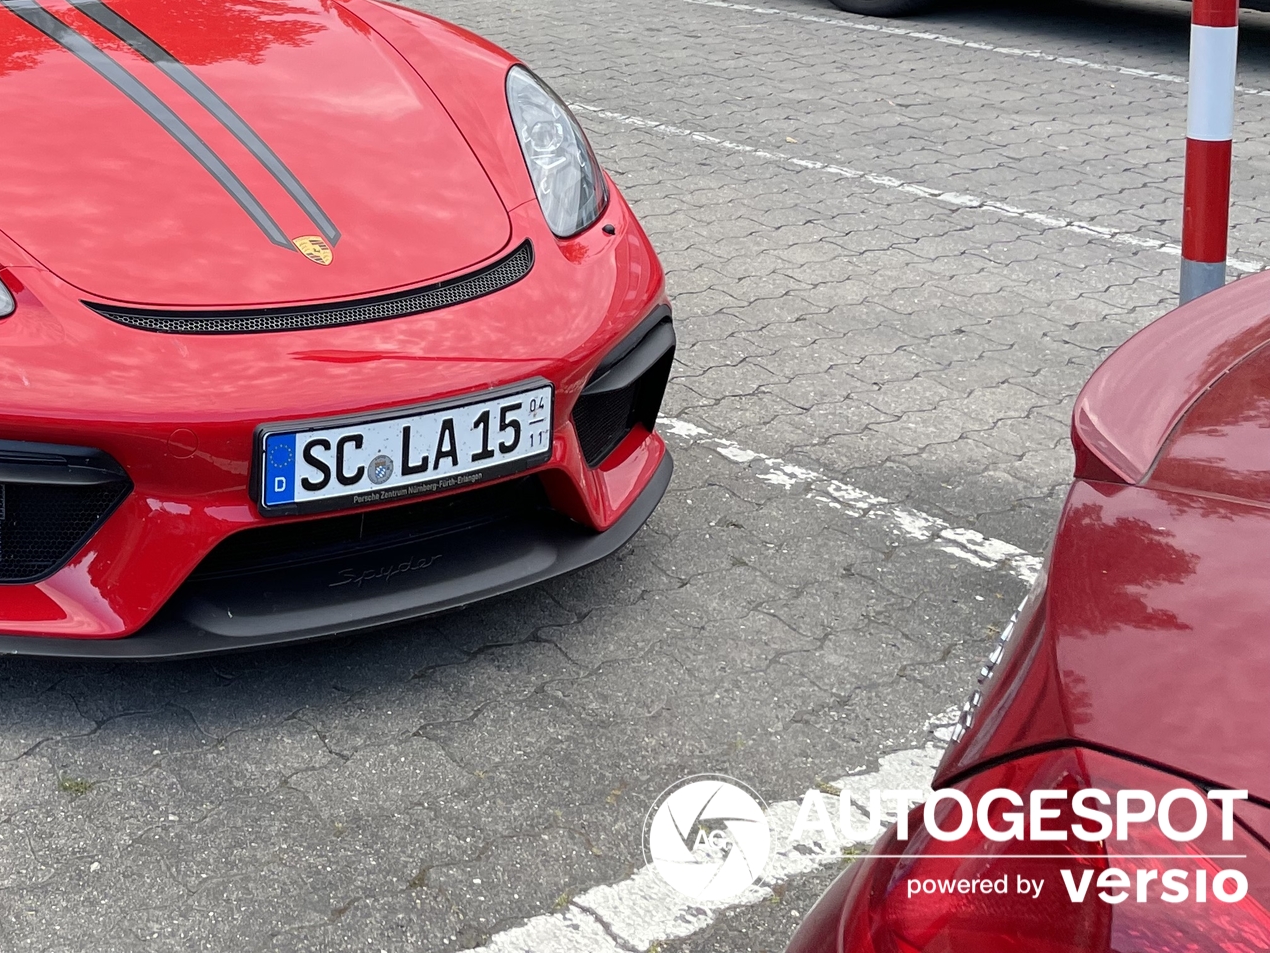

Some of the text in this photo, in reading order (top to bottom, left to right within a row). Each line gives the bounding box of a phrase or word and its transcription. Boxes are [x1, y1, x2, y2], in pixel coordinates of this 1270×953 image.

[529, 397, 545, 413] 04
[529, 433, 544, 449] 11
[301, 434, 365, 491] SC
[275, 477, 286, 493] D
[328, 554, 443, 588] Spyder
